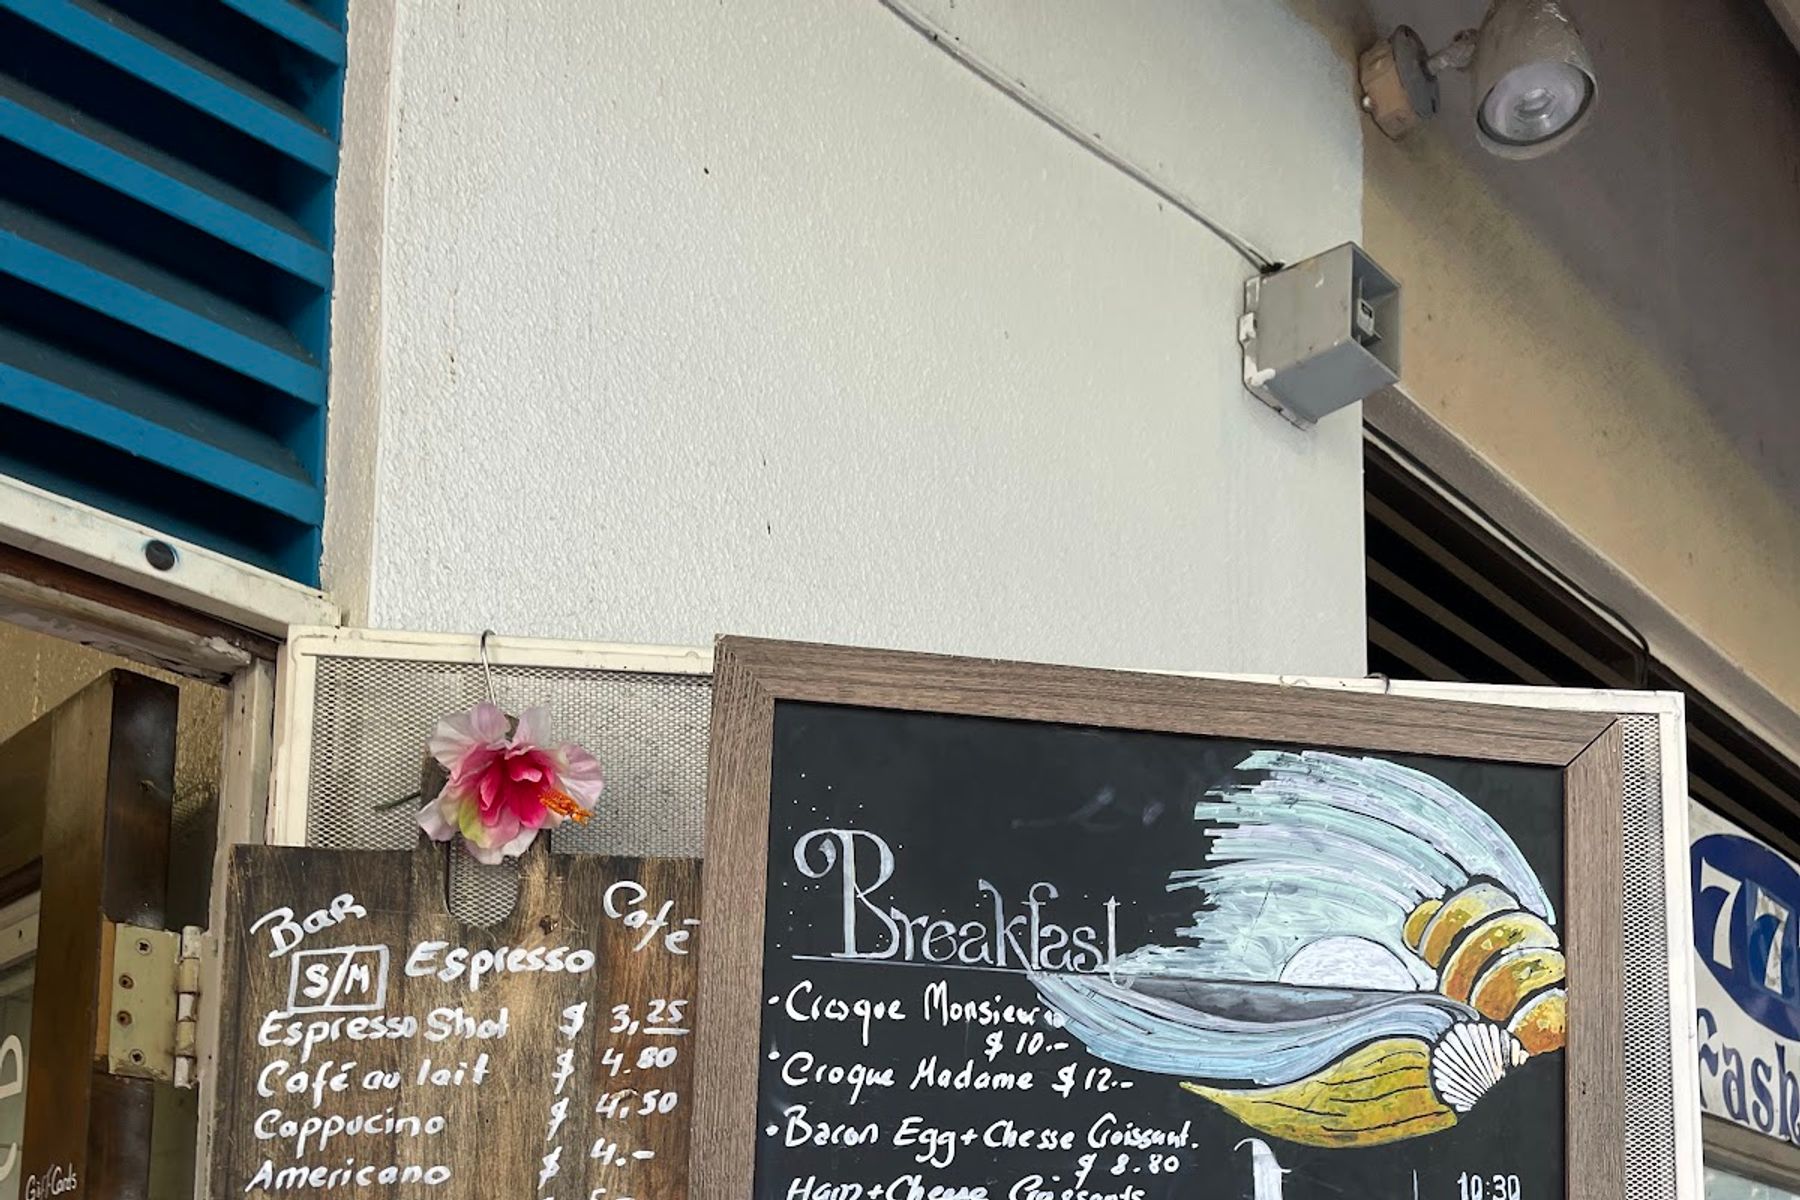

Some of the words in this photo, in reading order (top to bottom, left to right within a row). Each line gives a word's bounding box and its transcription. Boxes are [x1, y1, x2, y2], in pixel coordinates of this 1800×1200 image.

[793, 827, 1124, 980] Breakfast
[1700, 857, 1800, 994] 77
[404, 940, 596, 991] Espresso
[257, 1008, 417, 1063] Espresso
[423, 1007, 511, 1041] Shot
[785, 980, 906, 1046] Croque
[257, 1060, 350, 1109] Café
[363, 1070, 401, 1091] au
[418, 1053, 489, 1088] lait
[781, 1051, 895, 1105] Croque
[909, 1056, 1034, 1092] Madame
[253, 1109, 446, 1159] Cappucino
[783, 1105, 880, 1149] Bacon
[245, 1159, 451, 1193] Americano
